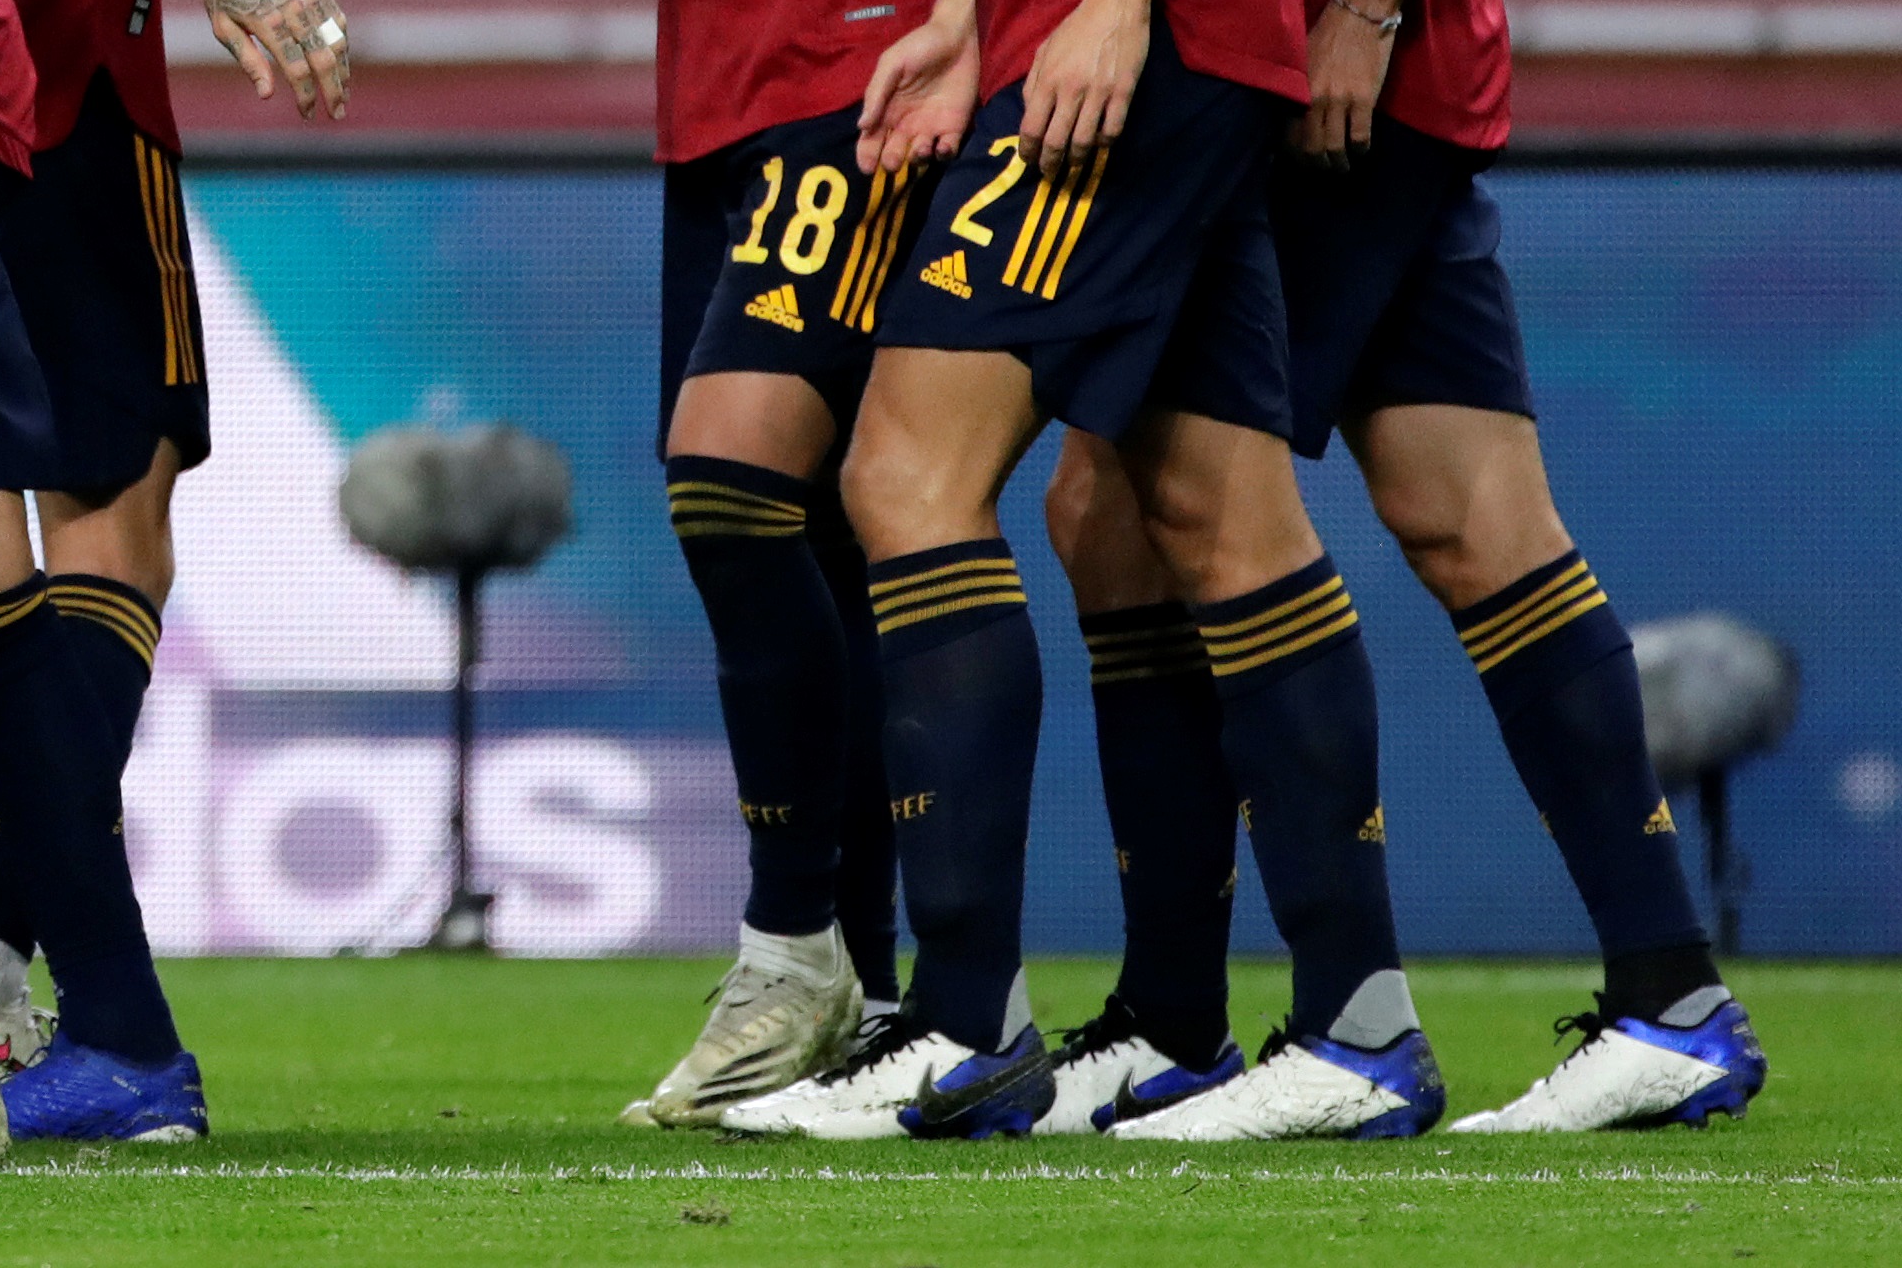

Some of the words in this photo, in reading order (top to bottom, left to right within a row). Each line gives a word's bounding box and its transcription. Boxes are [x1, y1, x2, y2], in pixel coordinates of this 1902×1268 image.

[732, 155, 849, 275] 18
[950, 135, 1026, 247] 2
[744, 299, 805, 334] adidas
[920, 265, 973, 300] adidas
